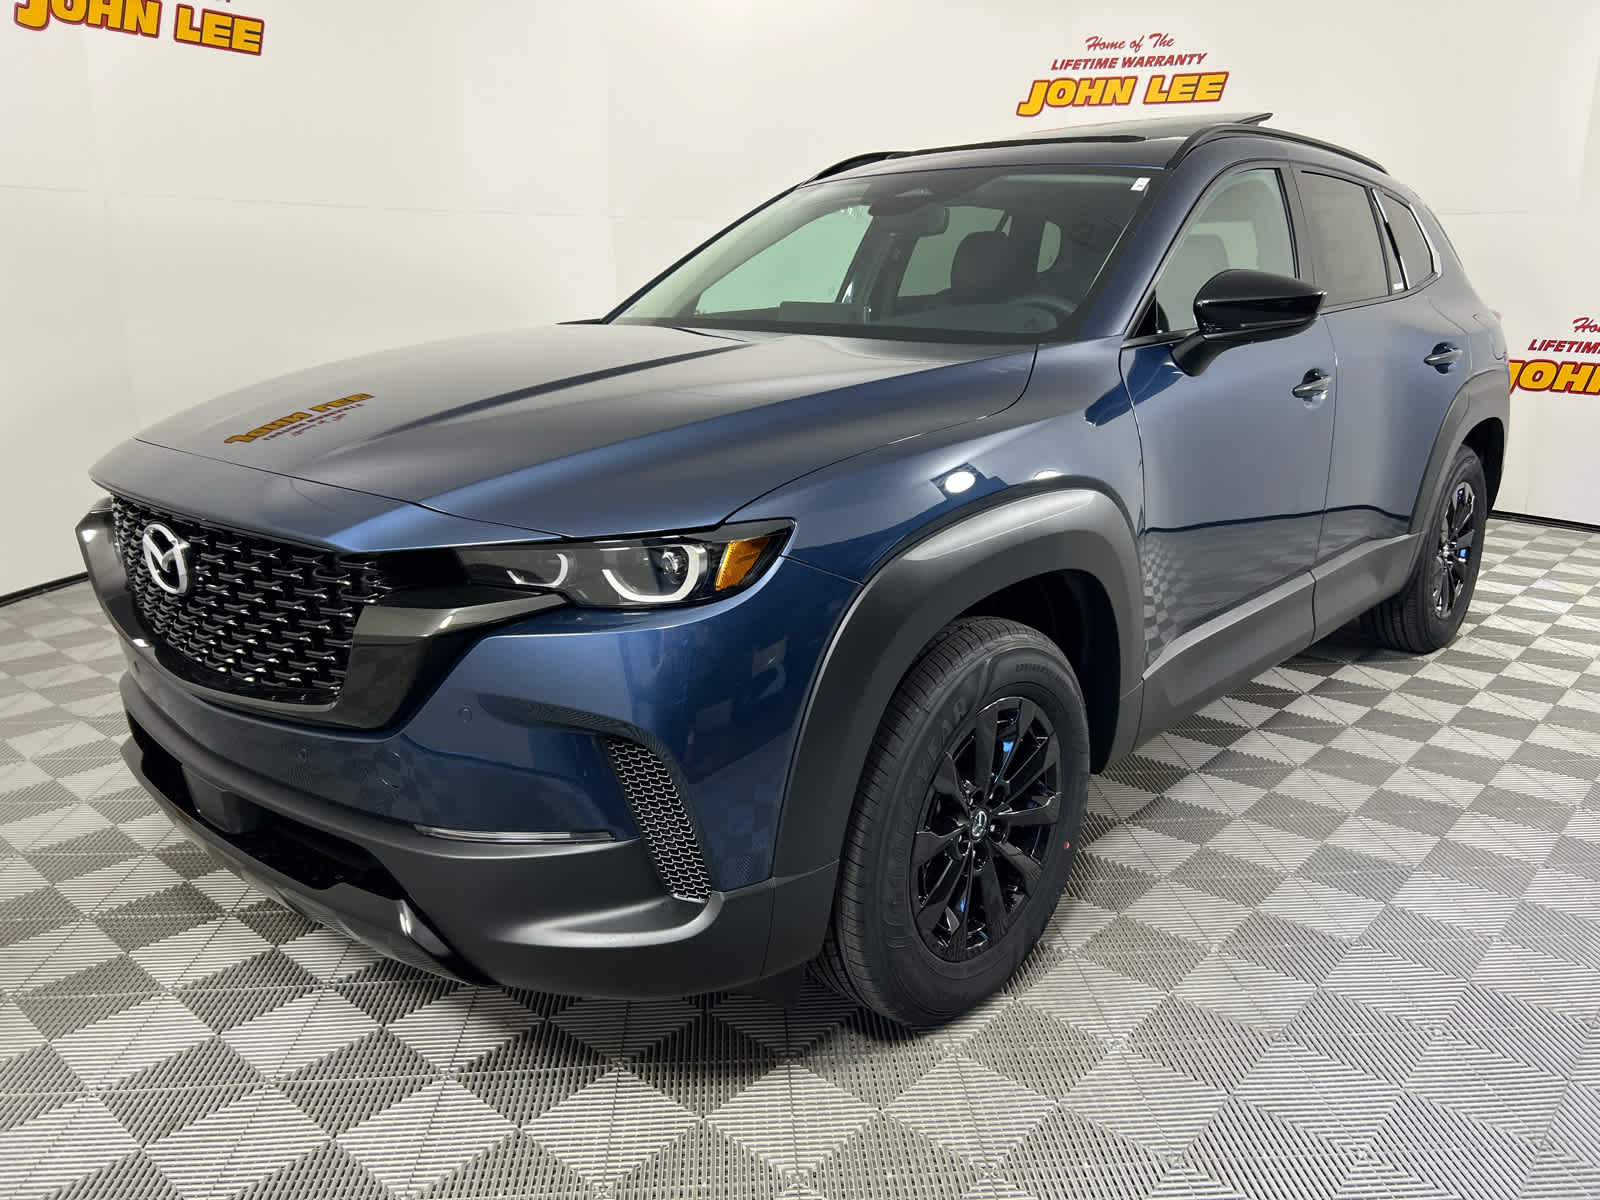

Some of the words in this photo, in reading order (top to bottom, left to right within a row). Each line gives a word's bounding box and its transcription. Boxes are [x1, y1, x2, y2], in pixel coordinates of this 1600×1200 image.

[14, 0, 162, 39] JOHN
[174, 3, 265, 56] LEE
[1085, 36, 1126, 51] Home
[1129, 35, 1145, 53] of
[1149, 33, 1175, 48] The
[1051, 57, 1119, 71] LIFETIME
[1122, 53, 1208, 68] WARRANTY
[1016, 76, 1138, 117] JOHN
[1143, 71, 1229, 104] LEE
[1573, 317, 1600, 333] Ho
[1528, 339, 1600, 354] LIFETIM
